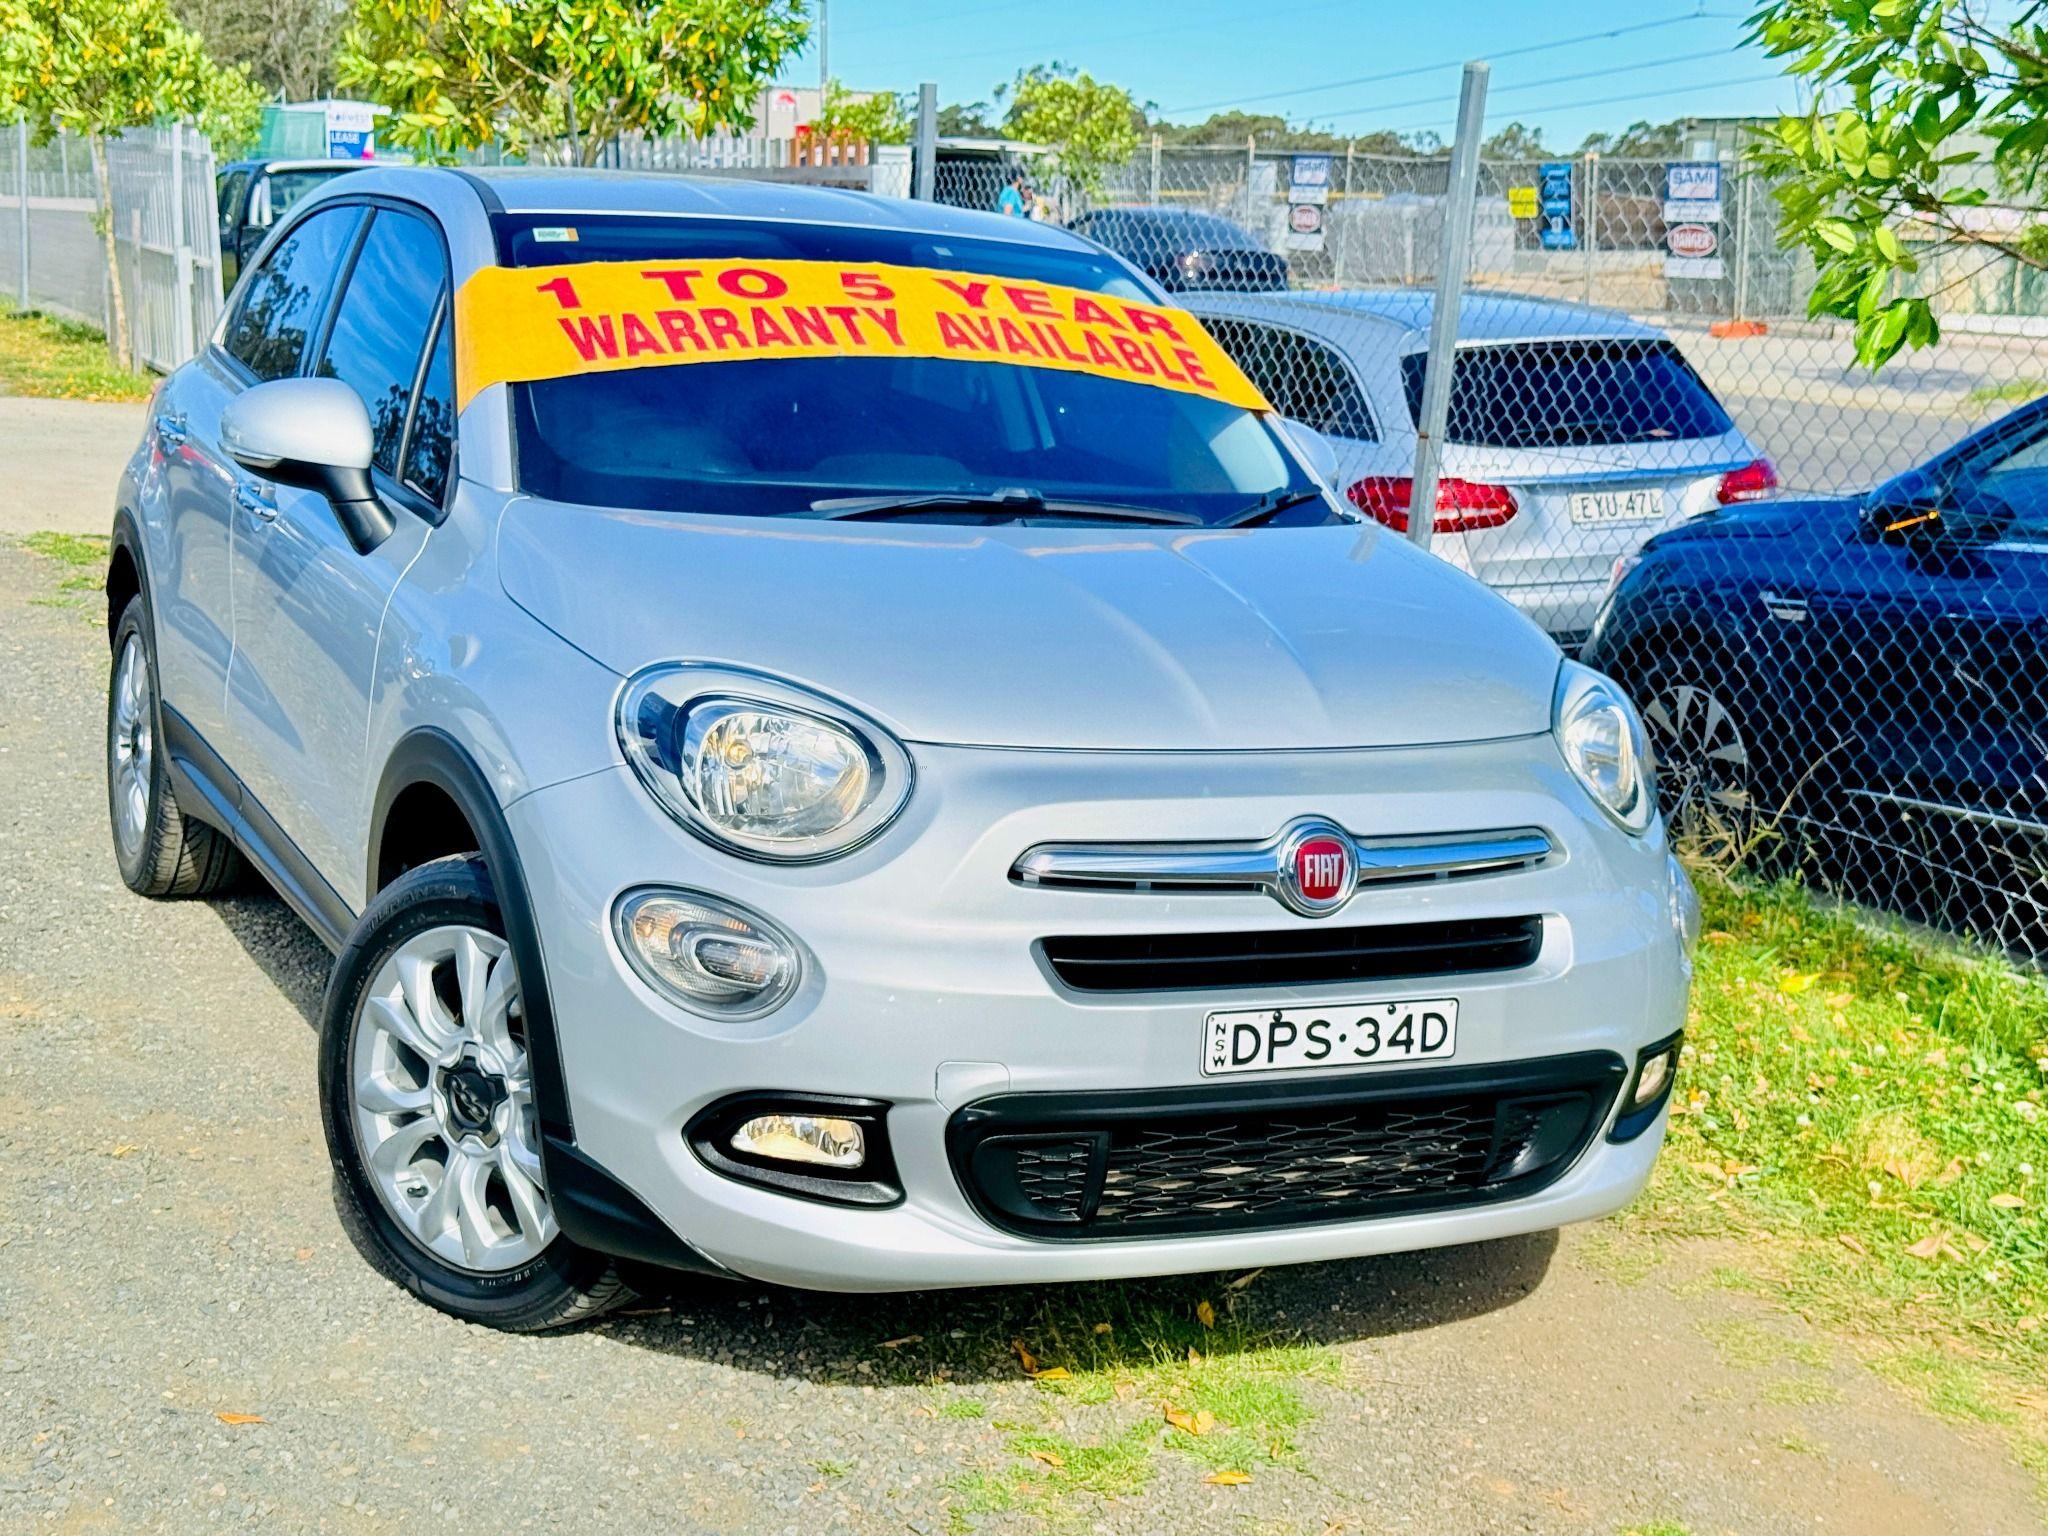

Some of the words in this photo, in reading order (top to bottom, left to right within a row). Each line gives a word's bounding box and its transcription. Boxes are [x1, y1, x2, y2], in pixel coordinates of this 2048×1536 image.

[1672, 168, 1713, 185] SAMI
[536, 277, 583, 309] 1
[640, 268, 789, 301] TO
[840, 272, 897, 301] 5
[933, 278, 1188, 344] YEAR
[557, 306, 906, 361] WARRANTY
[936, 311, 1217, 391] AVAILABLE
[1304, 853, 1341, 888] FIAT
[1212, 1023, 1227, 1067] NSW
